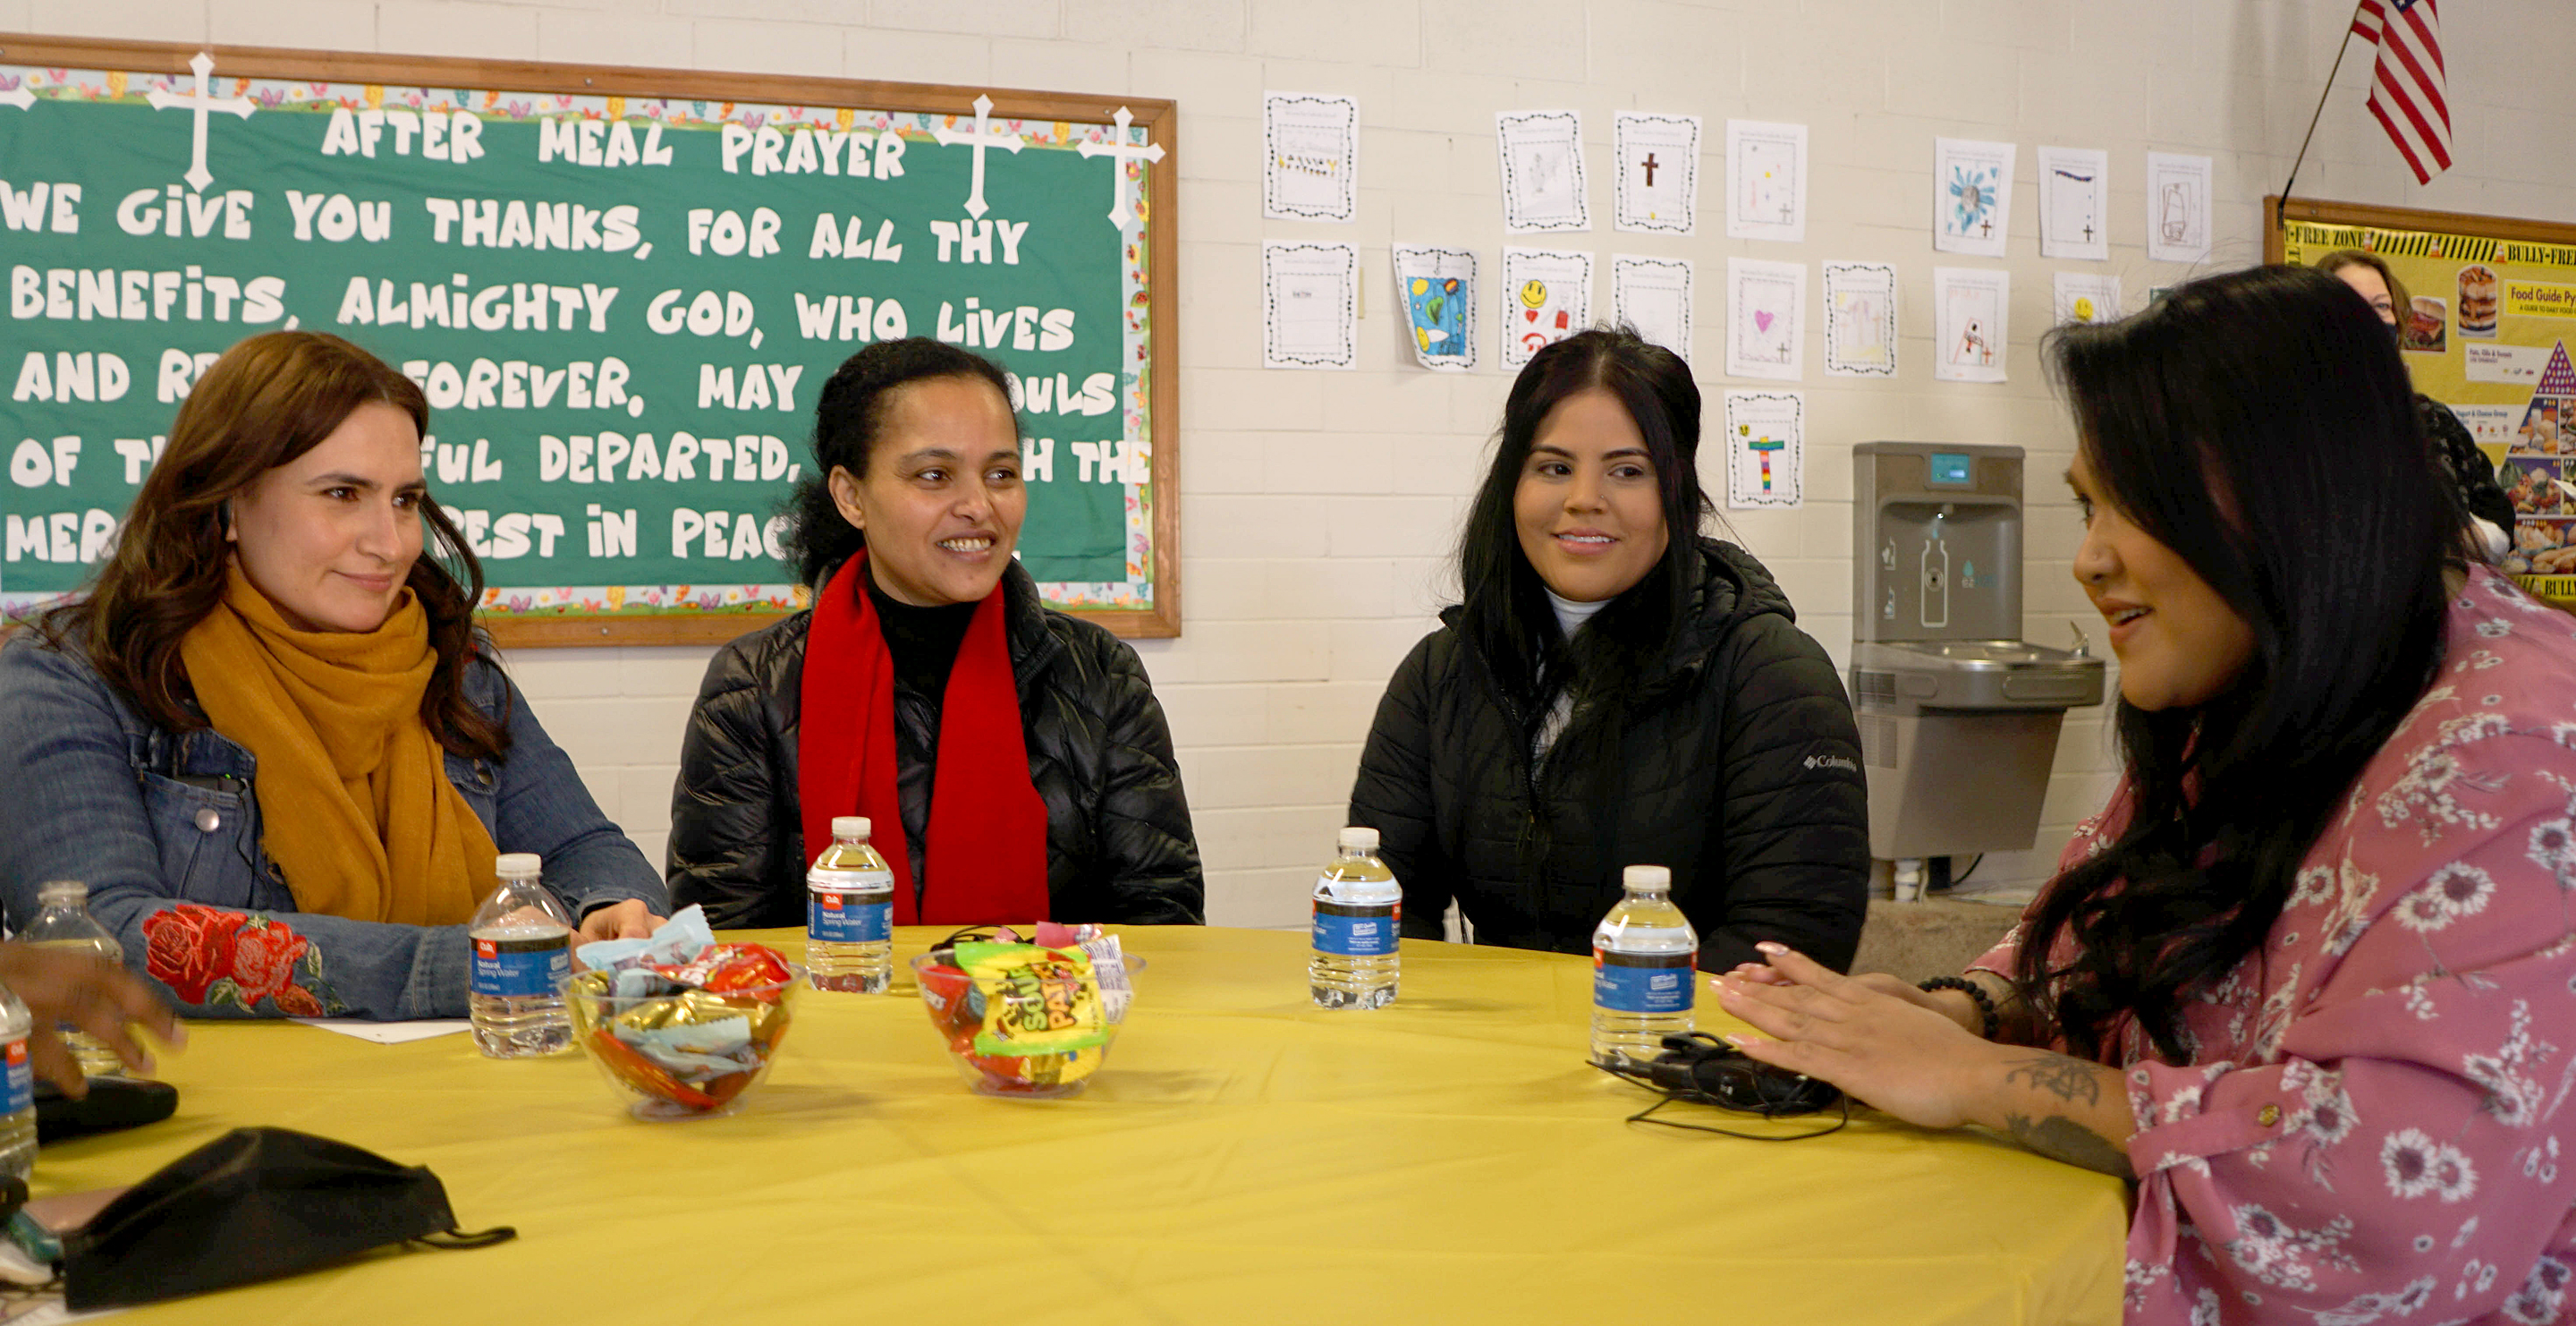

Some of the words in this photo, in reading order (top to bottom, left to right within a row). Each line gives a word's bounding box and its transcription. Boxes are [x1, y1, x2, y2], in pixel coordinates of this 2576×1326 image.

[321, 108, 486, 165] AFTER
[538, 116, 674, 168] MEAL
[721, 124, 907, 180] PRAYER
[0, 180, 82, 234] WE
[426, 198, 654, 261] THANKS,
[687, 207, 783, 259] FOR
[808, 212, 903, 263] ALL
[929, 218, 1030, 266] THY
[2333, 229, 2365, 248] ZONE
[646, 288, 765, 351] GOD,
[793, 292, 908, 343] WHO
[2511, 286, 2534, 301] Food
[2536, 288, 2562, 302] Guide
[12, 352, 131, 403] AND
[698, 363, 804, 412] MAY
[1005, 372, 1117, 417] OULS
[10, 435, 81, 488] OF
[539, 430, 801, 484] DEPARTED,
[1070, 438, 1153, 484] THE
[5, 508, 127, 563] MER
[672, 507, 792, 561] PEAC
[1008, 965, 1048, 1031] SOUR
